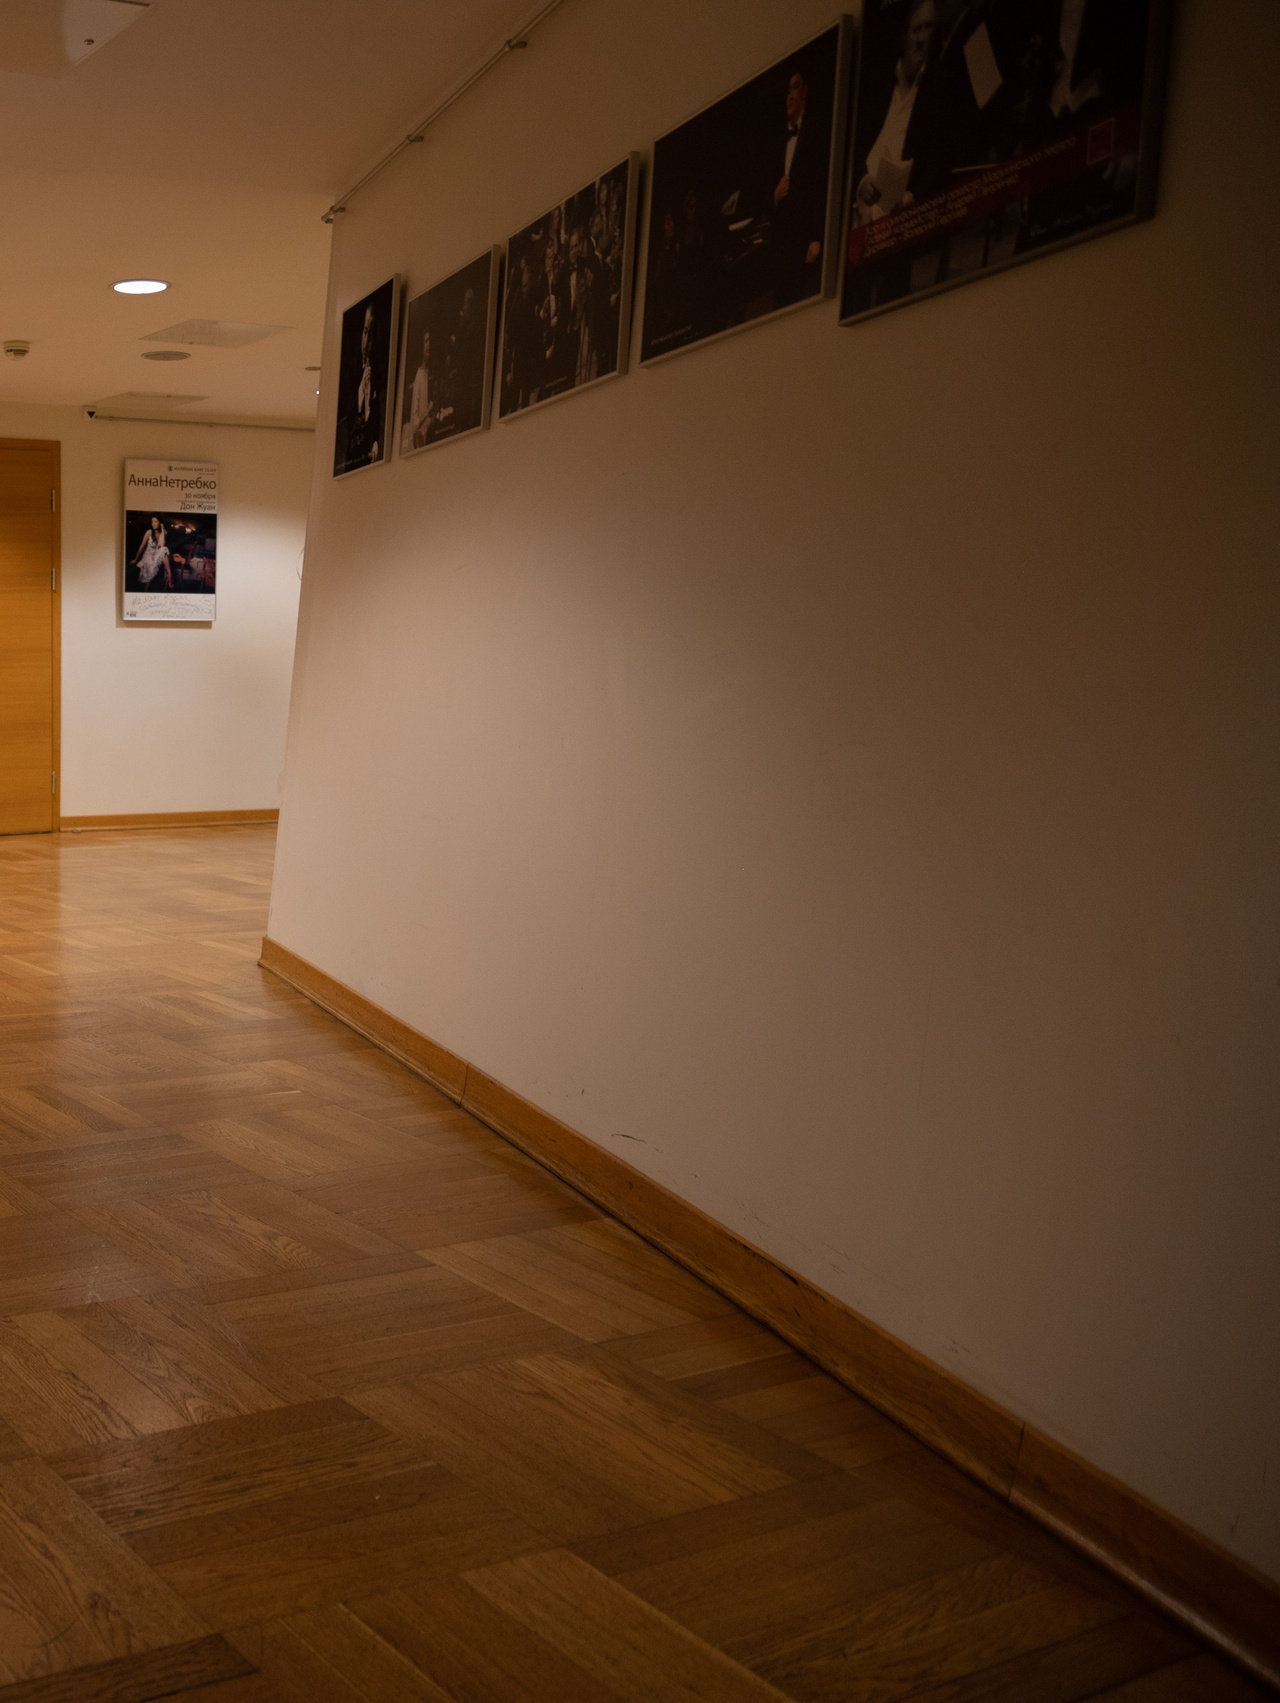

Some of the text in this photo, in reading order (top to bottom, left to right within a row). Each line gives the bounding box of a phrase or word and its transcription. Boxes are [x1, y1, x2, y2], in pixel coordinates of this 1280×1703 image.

[128, 474, 216, 491] АннаНетребко
[193, 492, 216, 500] ноября
[180, 502, 216, 512] Дон Жуан
